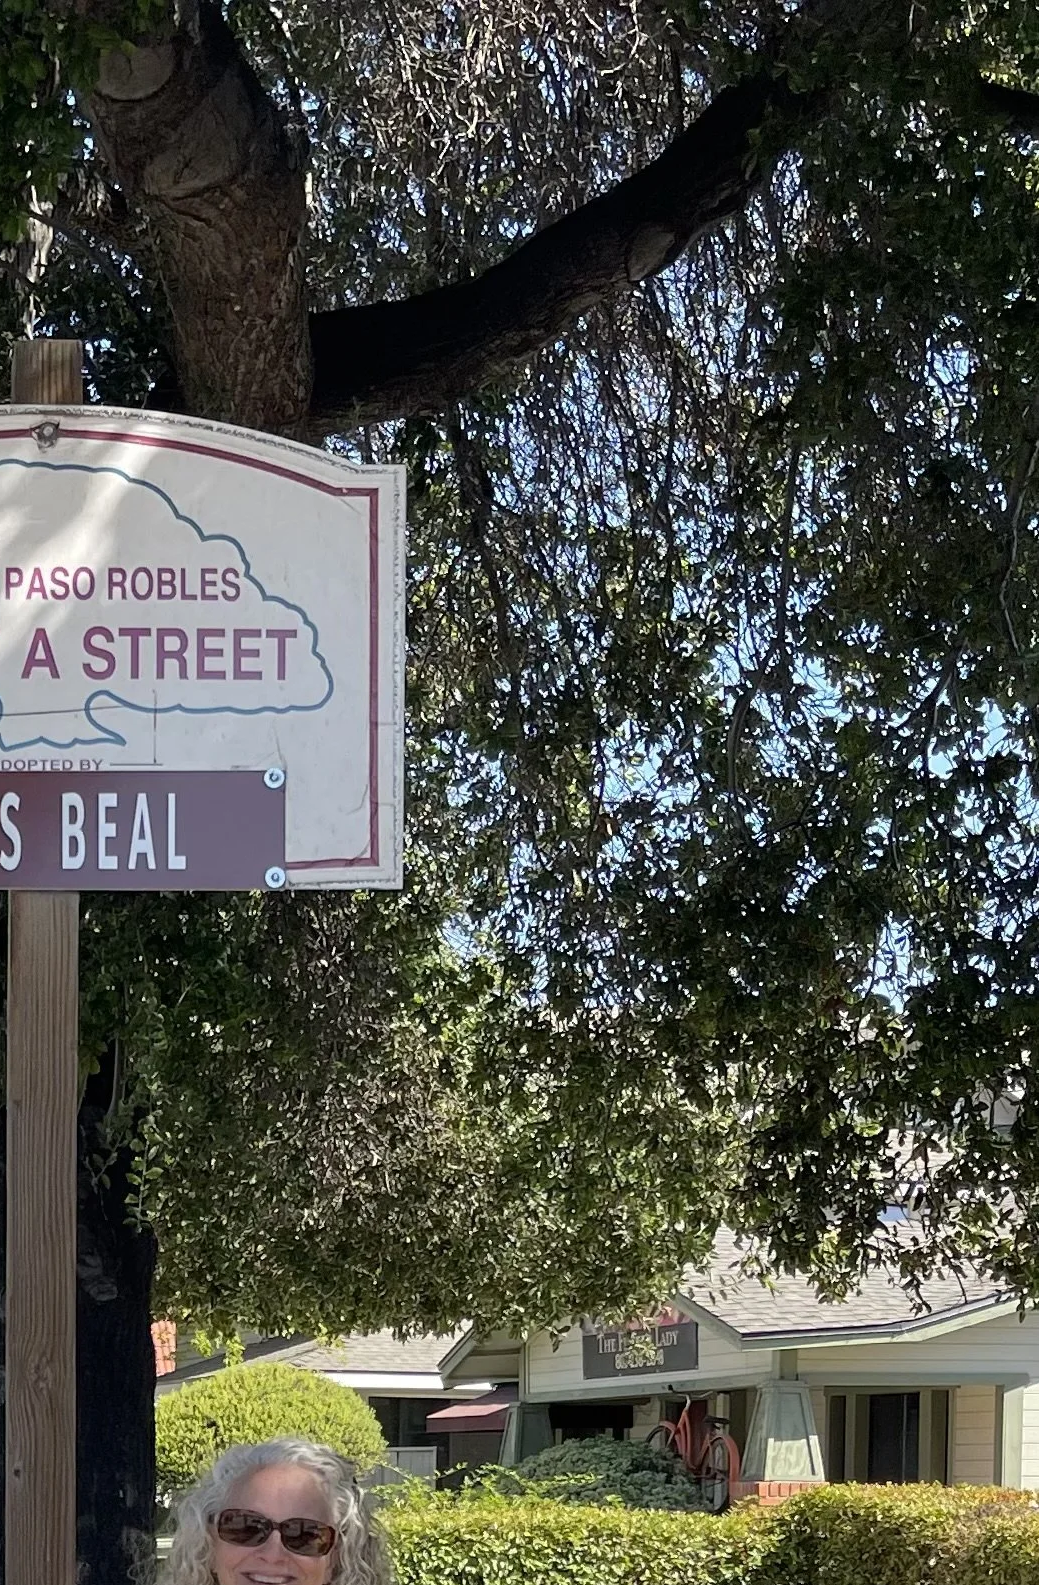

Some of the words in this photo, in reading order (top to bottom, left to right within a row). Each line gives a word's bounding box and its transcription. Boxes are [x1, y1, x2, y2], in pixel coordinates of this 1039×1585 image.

[5, 567, 96, 601] PASO
[108, 567, 242, 601] ROBLES
[21, 627, 61, 680] A
[82, 627, 298, 681] STREET
[80, 759, 103, 772] BY
[62, 792, 188, 871] BEAL
[655, 1327, 679, 1347] LADY
